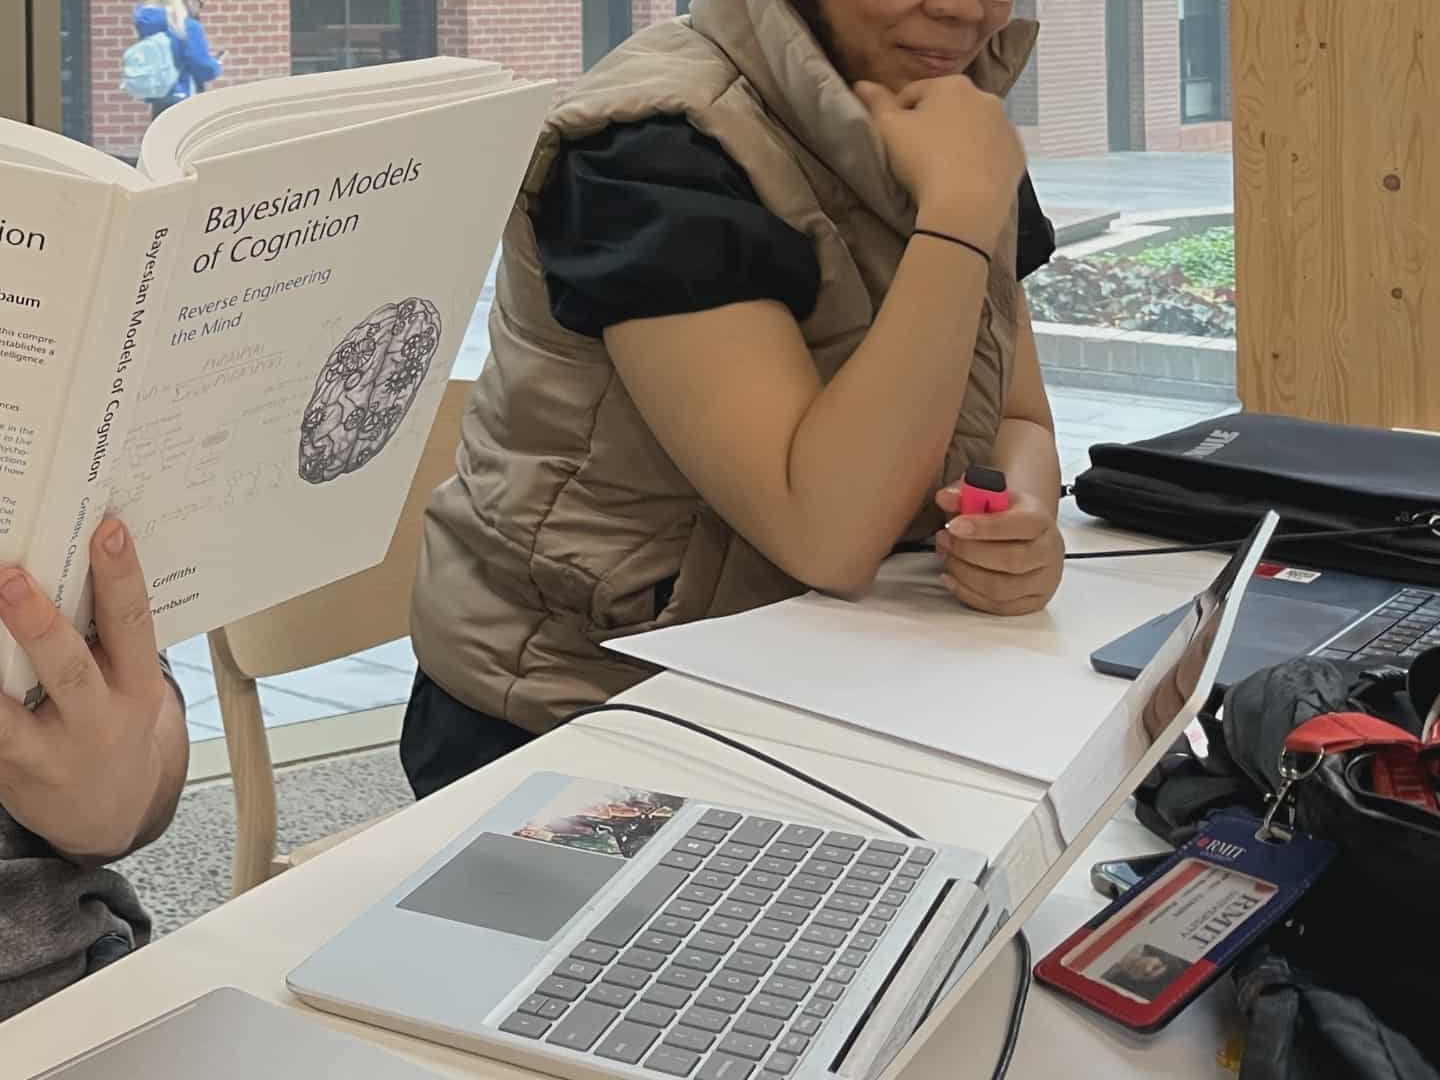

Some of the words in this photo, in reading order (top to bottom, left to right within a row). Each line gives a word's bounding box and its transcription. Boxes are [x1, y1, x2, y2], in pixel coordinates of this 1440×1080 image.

[204, 187, 321, 235] Bayesian
[328, 157, 422, 203] Models
[136, 227, 168, 305] Bayesian
[193, 242, 224, 273] of
[230, 214, 359, 262] Cognition
[177, 294, 238, 322] Reverse
[242, 268, 332, 303] Engineering
[16, 331, 56, 345] compre-
[116, 309, 145, 373] Models
[171, 326, 197, 346] the
[201, 312, 243, 337] Mind
[111, 378, 124, 395] of
[87, 399, 120, 483] Cognition
[149, 592, 200, 615] nenbaum
[152, 566, 197, 588] Griffiths
[1206, 839, 1248, 859] RMIT
[1192, 893, 1260, 949] RMIT
